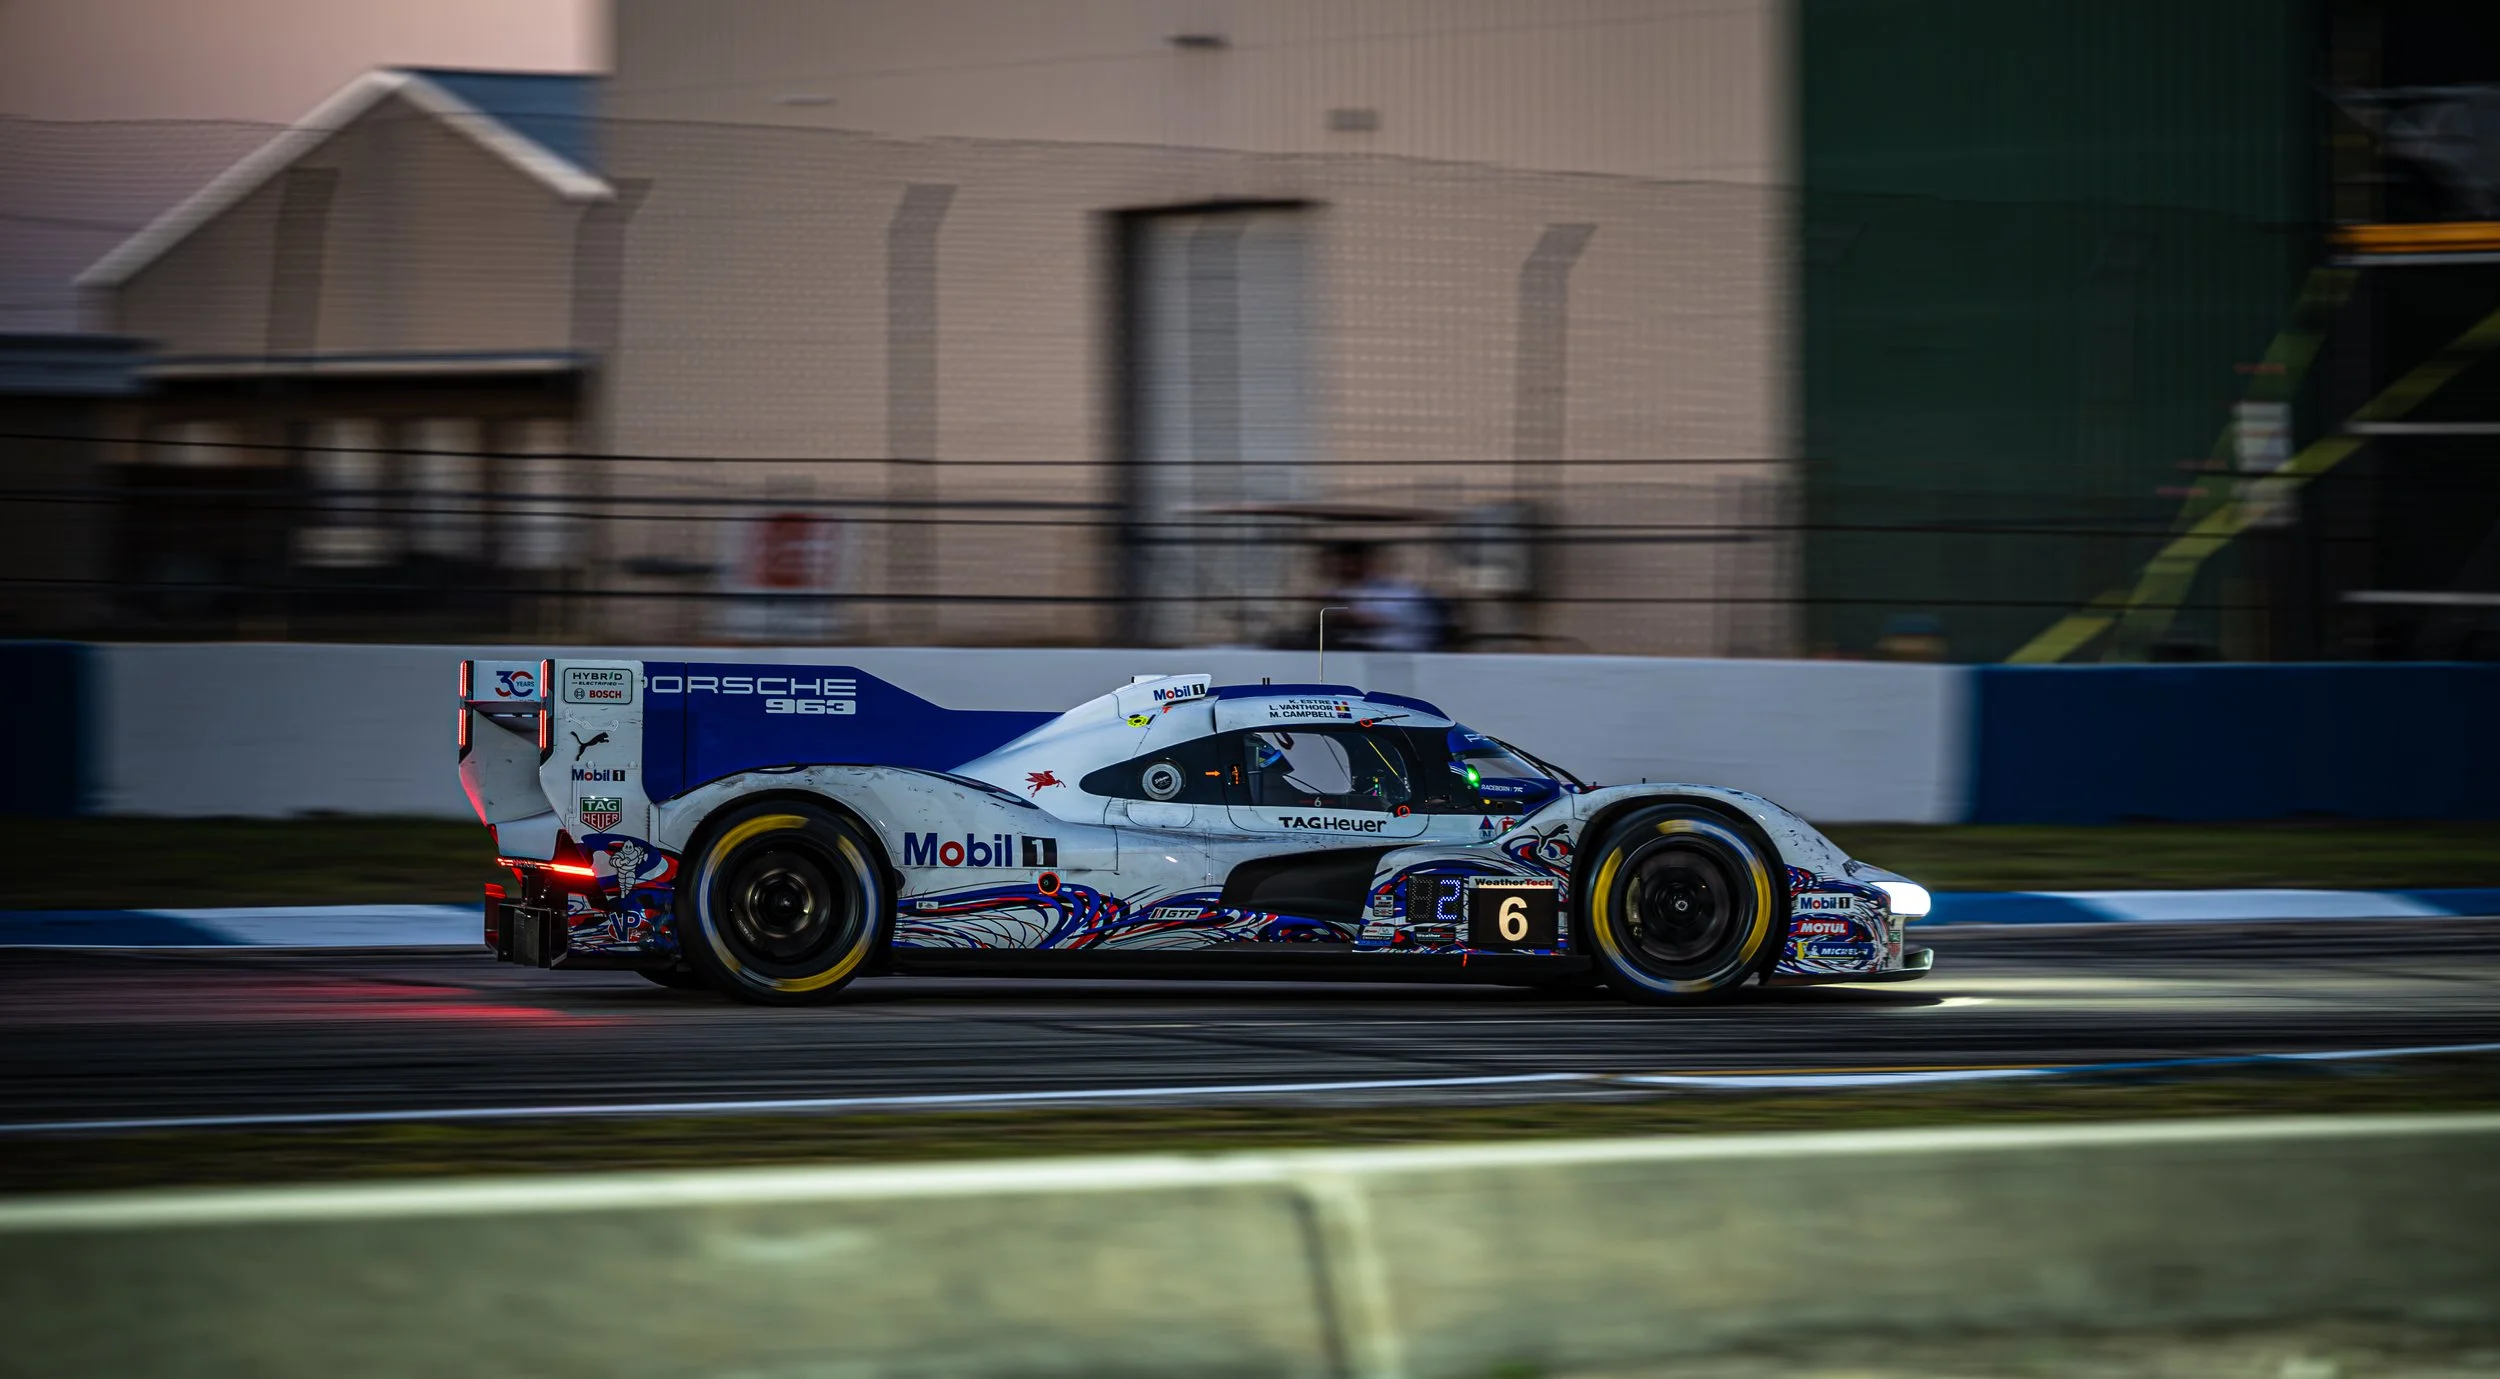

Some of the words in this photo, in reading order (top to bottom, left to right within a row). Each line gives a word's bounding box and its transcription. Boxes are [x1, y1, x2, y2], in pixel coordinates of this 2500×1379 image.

[495, 671, 534, 697] 30
[644, 676, 856, 696] ORSCHE
[589, 690, 622, 698] BOSCH
[1153, 685, 1191, 701] Mobil
[766, 699, 856, 714] 963
[572, 769, 610, 781] Mobil
[584, 801, 617, 811] TAG
[1314, 797, 1322, 807] 6
[584, 814, 618, 829] HEUER
[904, 832, 1012, 867] Mobil
[1475, 878, 1553, 886] WeatherTech
[1437, 879, 1460, 919] 2
[1800, 897, 1836, 909] Mobil
[1166, 910, 1198, 918] GTP
[1499, 896, 1528, 941] 6
[1800, 923, 1846, 933] MOTUL
